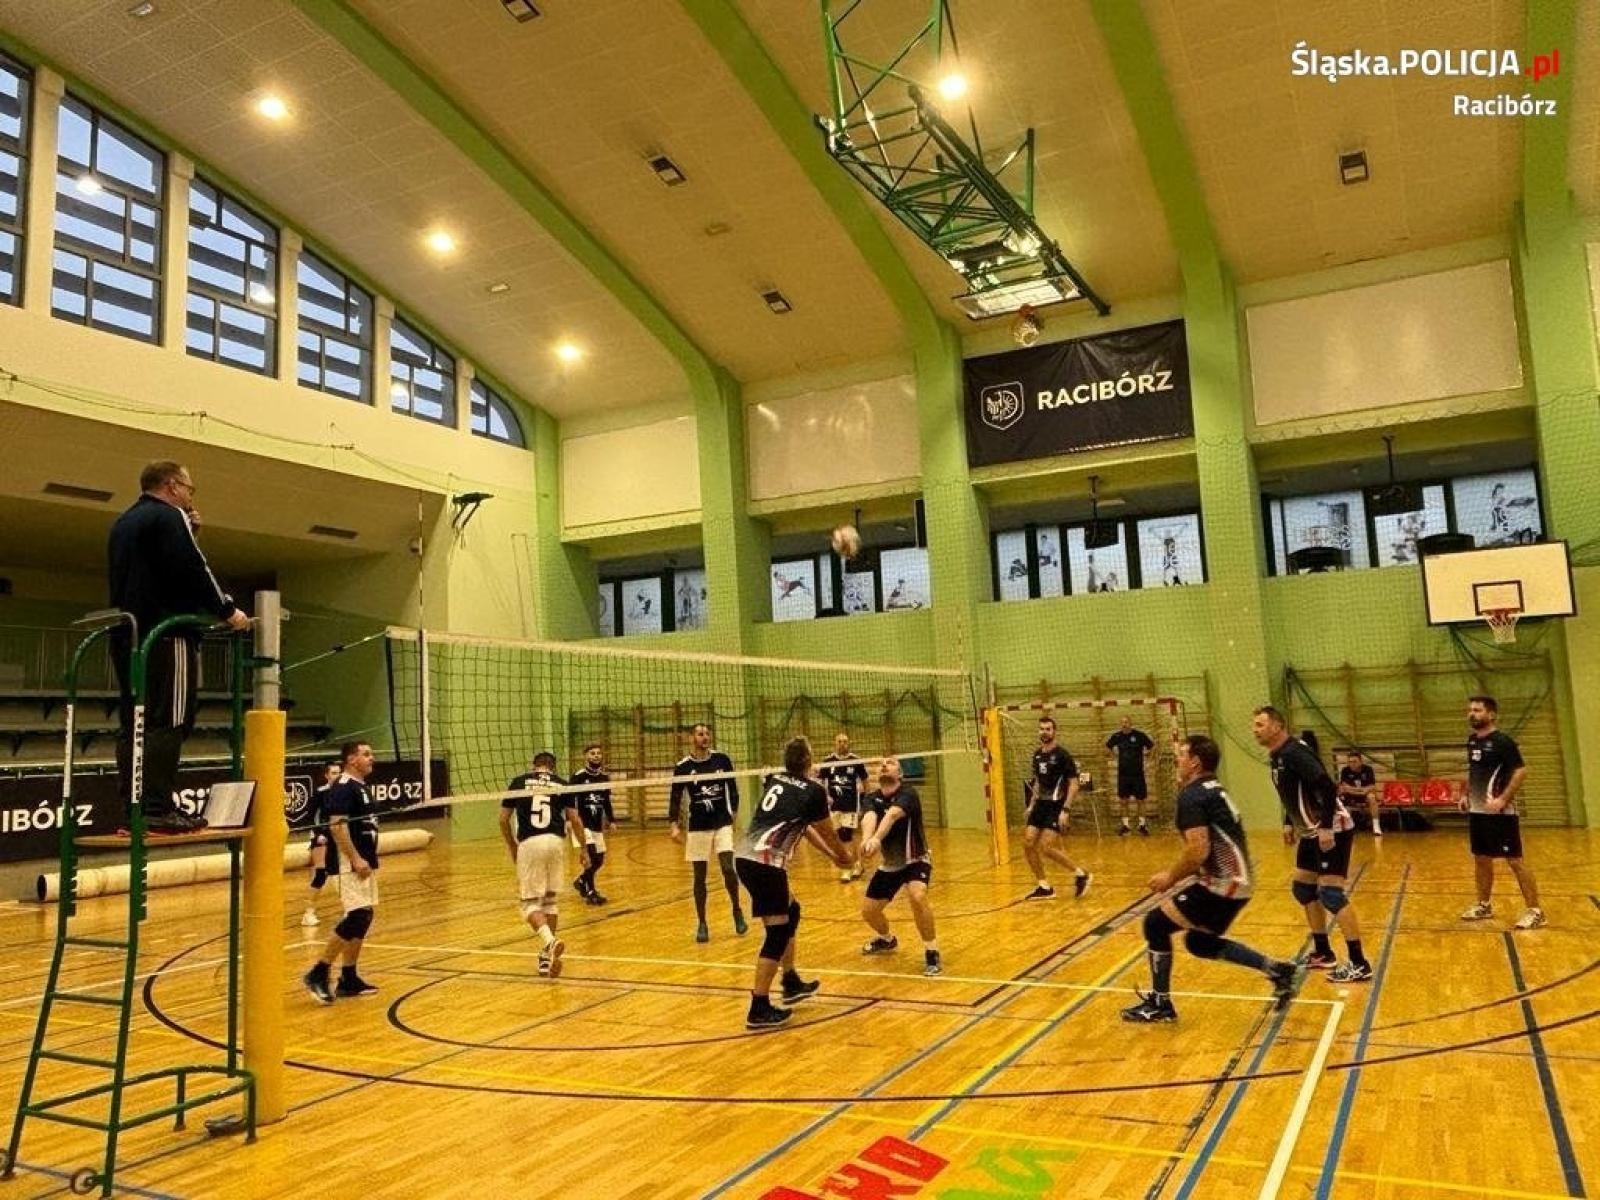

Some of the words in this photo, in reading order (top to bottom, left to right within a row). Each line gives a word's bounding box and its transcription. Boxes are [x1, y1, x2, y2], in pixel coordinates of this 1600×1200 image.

[1037, 369, 1174, 411] RACIBÓRZ
[530, 794, 551, 829] 5
[761, 784, 784, 812] 6
